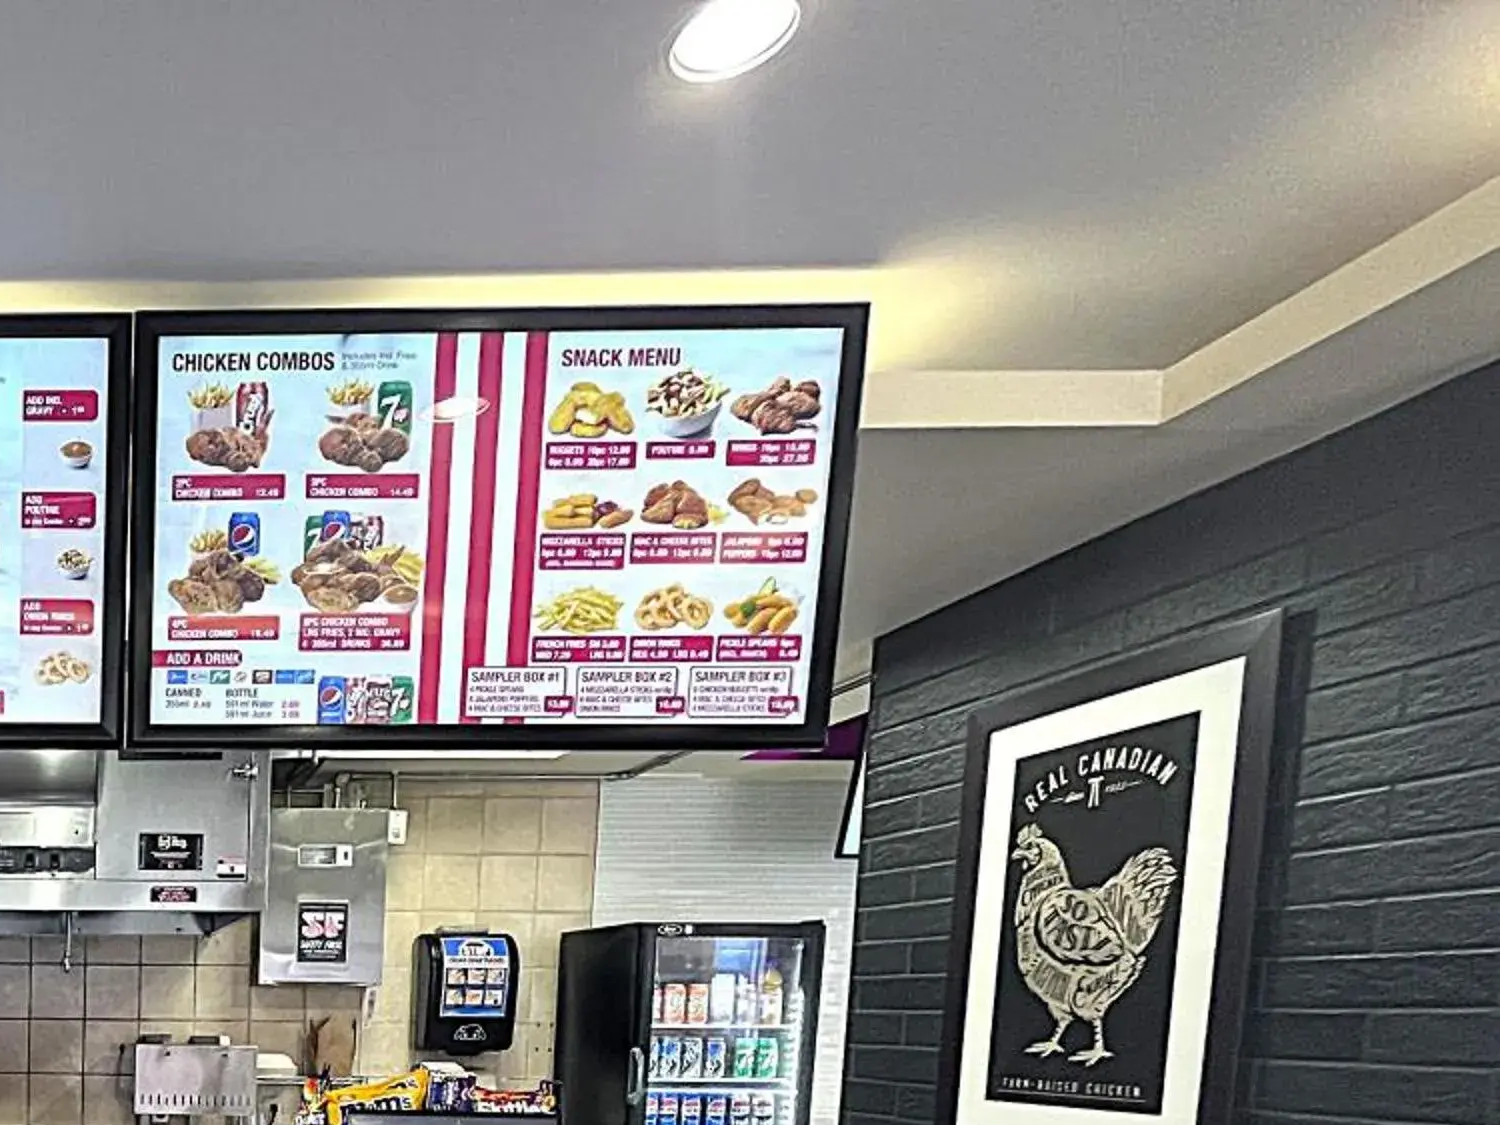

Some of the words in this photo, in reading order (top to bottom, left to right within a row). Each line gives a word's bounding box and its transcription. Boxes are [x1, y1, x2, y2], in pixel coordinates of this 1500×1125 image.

[172, 353, 250, 371] CHICKEN
[257, 352, 335, 370] COMBOS
[562, 349, 623, 367] SNACK
[628, 348, 681, 366] MENU
[167, 653, 191, 665] ADD
[193, 653, 203, 665] A
[204, 653, 241, 665] DRINK
[471, 672, 521, 682] SAMPLER
[523, 672, 545, 682] BOX
[582, 672, 632, 682] SAMPLER
[635, 672, 657, 682] BOX
[659, 672, 672, 682] #2
[695, 672, 746, 682] SAMPLER
[165, 688, 202, 697] CANNED
[225, 688, 259, 698] BOTTLE
[1024, 765, 1069, 813] REAL
[1078, 746, 1178, 785] CANADIAN
[1085, 1082, 1141, 1098] CHICKEN
